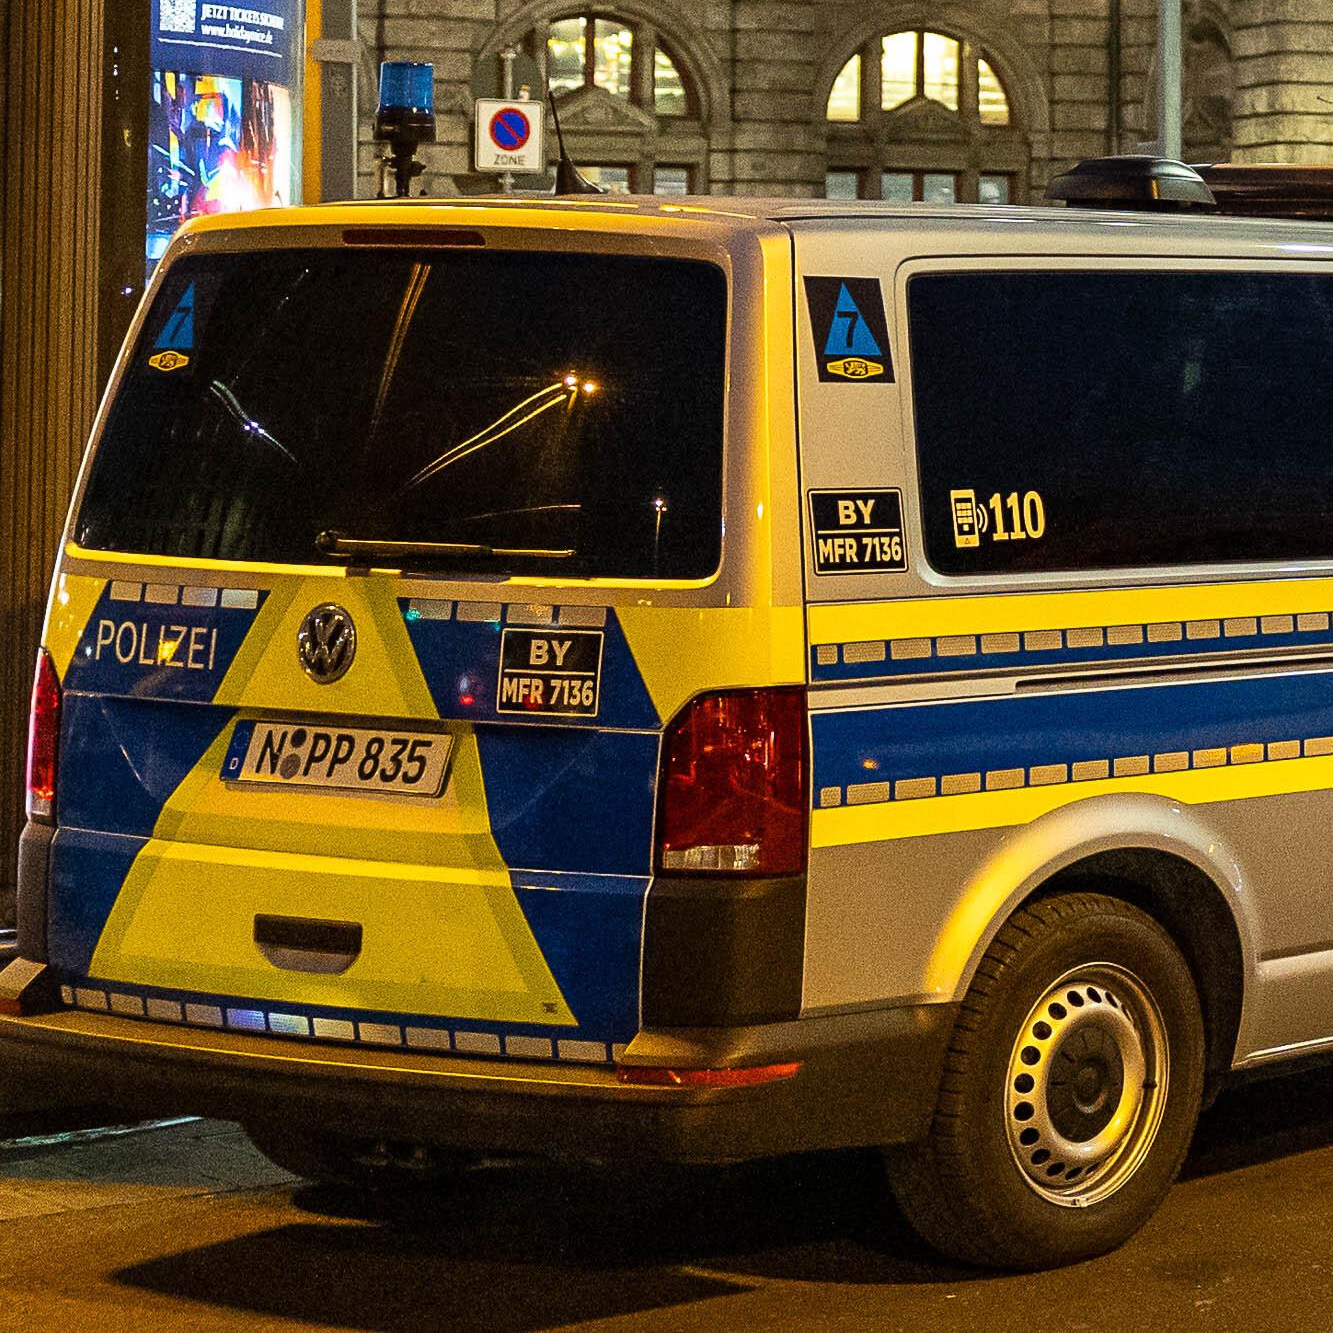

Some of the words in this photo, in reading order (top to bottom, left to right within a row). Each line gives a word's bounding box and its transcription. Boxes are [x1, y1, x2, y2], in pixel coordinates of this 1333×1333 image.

[493, 154, 526, 166] ZONE
[837, 311, 859, 348] 7
[837, 499, 876, 526] BY
[989, 490, 1046, 542] 110
[818, 537, 859, 565] MFR
[861, 536, 902, 564] 7136
[95, 618, 218, 671] POLIZEI
[529, 639, 573, 666] BY
[501, 676, 544, 705] MFR
[549, 678, 594, 707] 7136
[229, 757, 239, 770] D
[254, 729, 289, 775] N
[302, 731, 356, 778] PP
[357, 736, 433, 785] 835
